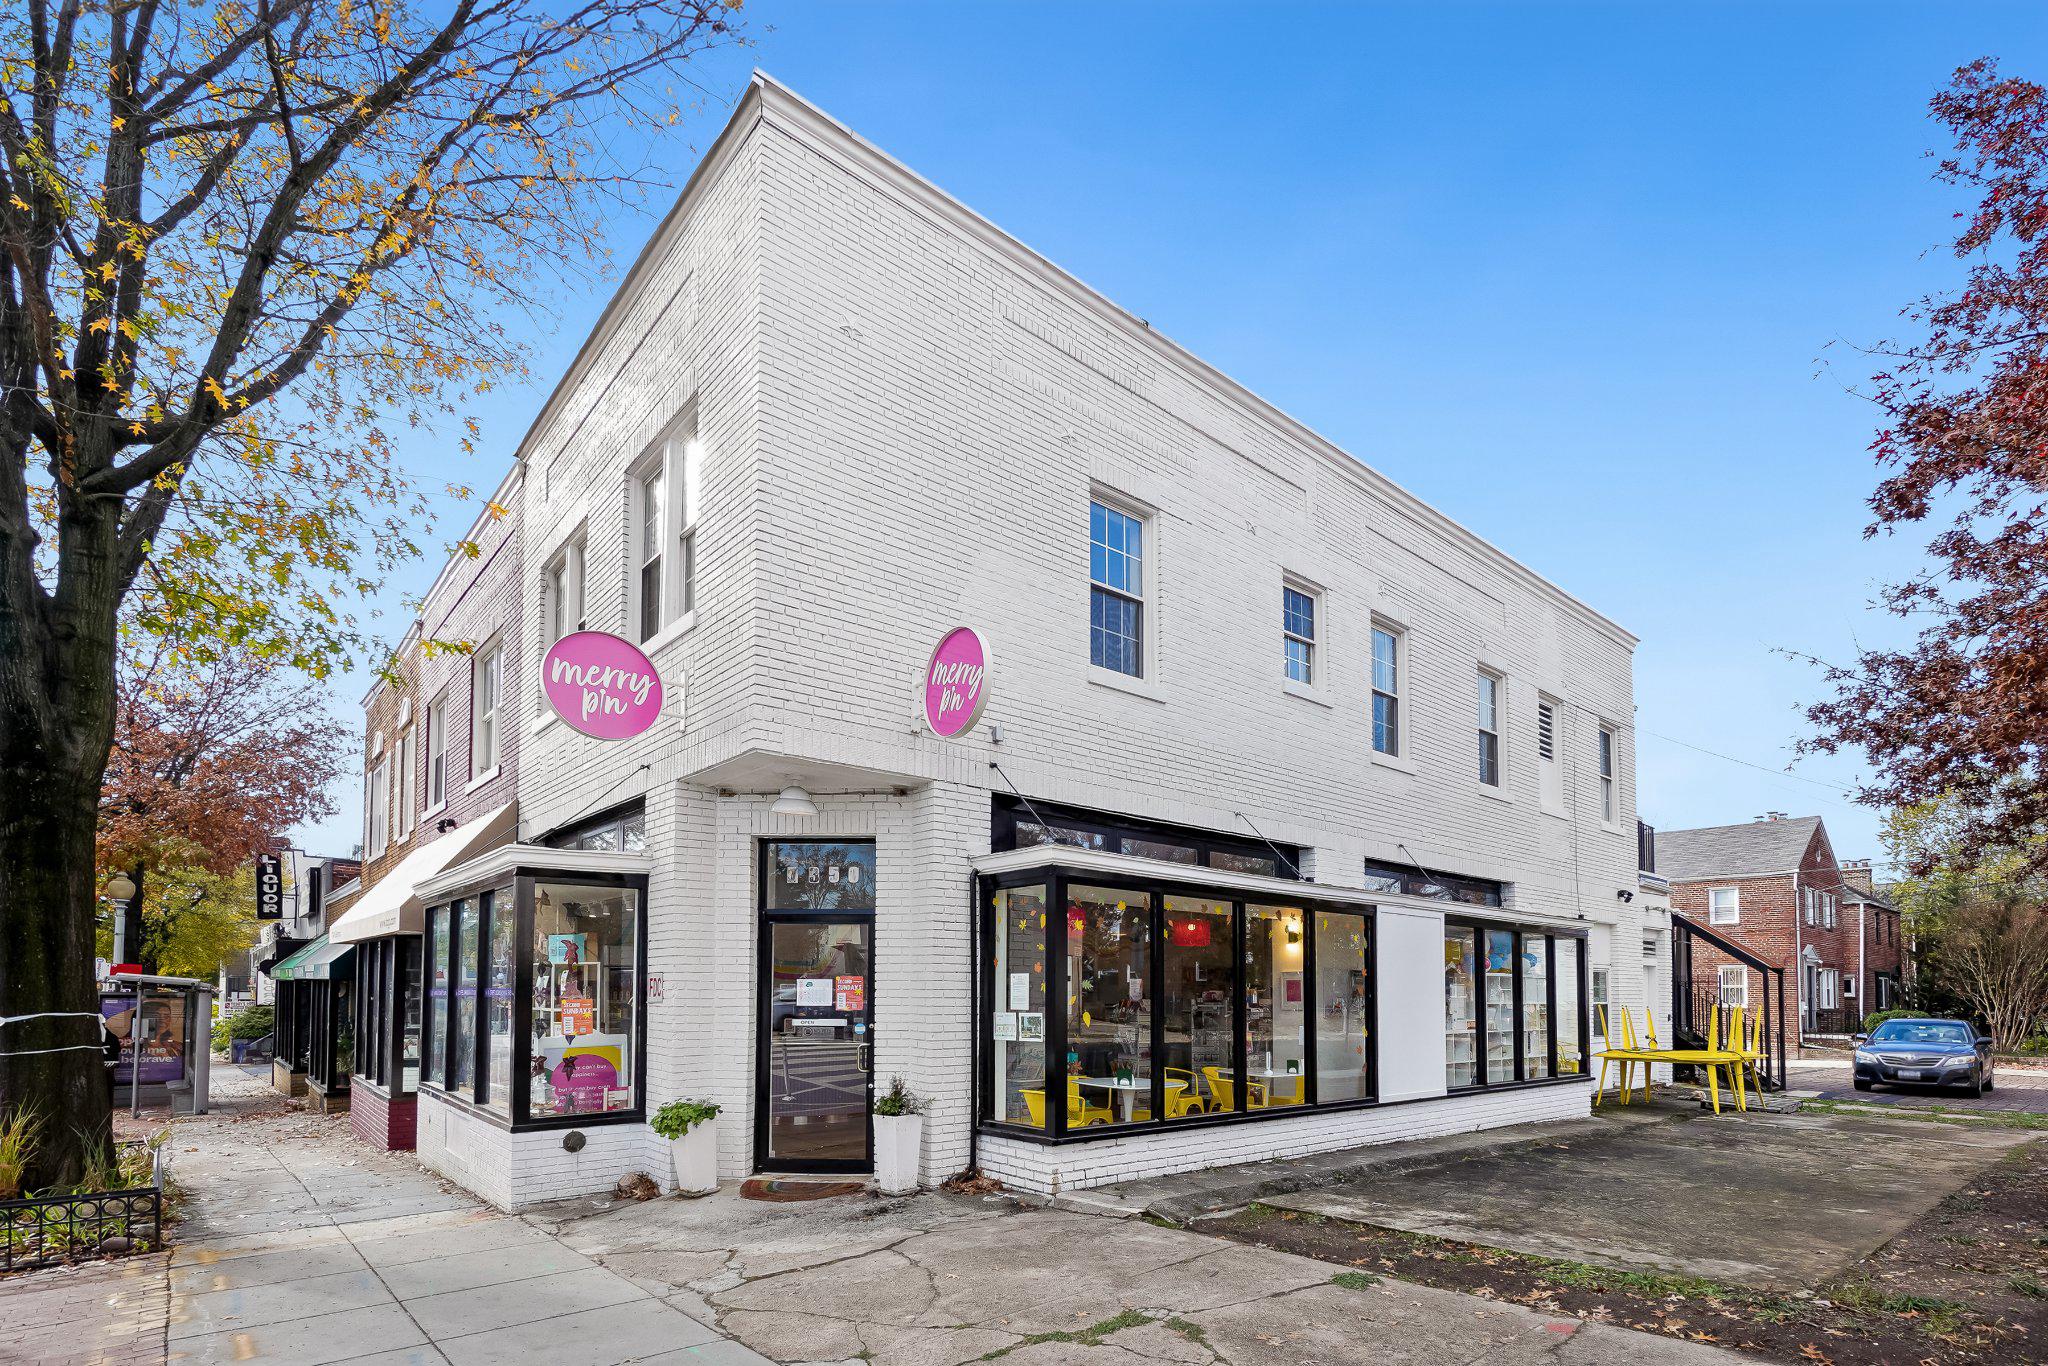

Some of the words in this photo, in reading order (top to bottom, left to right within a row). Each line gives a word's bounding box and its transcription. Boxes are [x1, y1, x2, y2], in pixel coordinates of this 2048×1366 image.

[551, 656, 656, 706] merry
[931, 660, 984, 700] merry
[582, 687, 628, 722] pin
[938, 685, 965, 721] pin
[261, 854, 279, 913] LIQUOR
